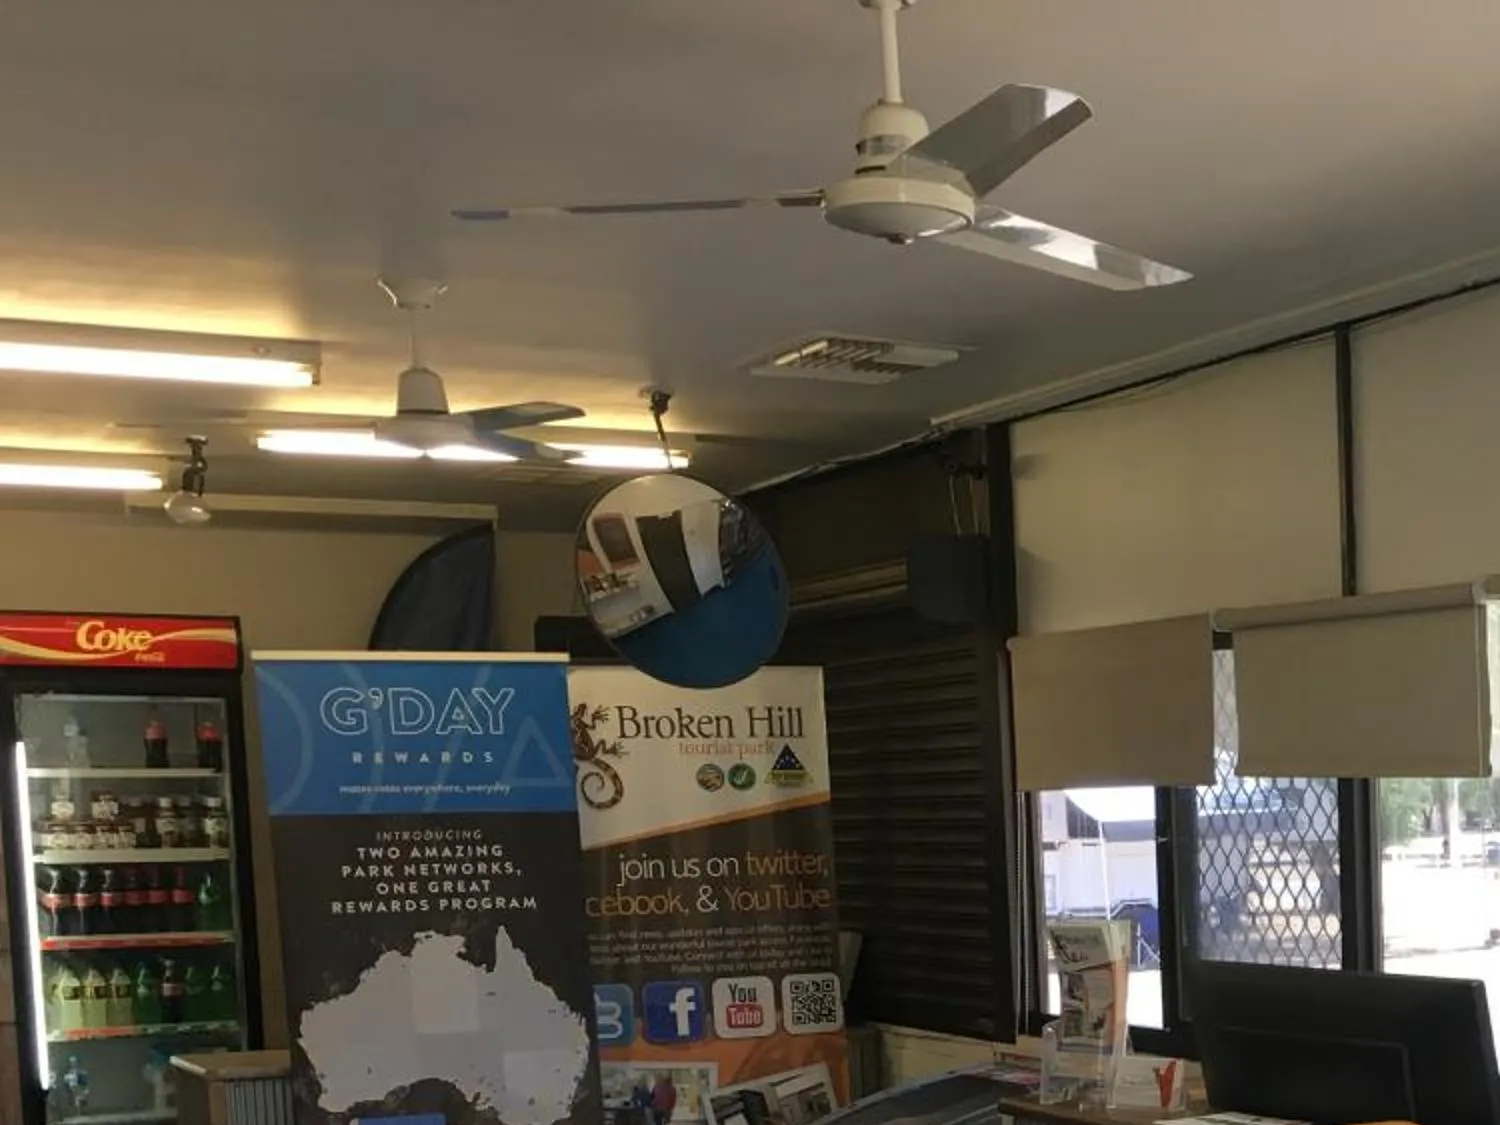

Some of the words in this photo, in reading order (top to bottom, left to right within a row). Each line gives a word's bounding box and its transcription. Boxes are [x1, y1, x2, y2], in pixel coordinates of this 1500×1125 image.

[75, 620, 154, 651] Coke
[319, 686, 516, 736] G'DAY
[614, 705, 736, 739] Broken
[745, 705, 806, 739] Hill
[352, 751, 494, 764] REWARDS
[376, 830, 482, 841] INTRODUCING
[357, 847, 401, 860] TWO
[411, 845, 503, 859] AMAZING
[341, 865, 395, 878] PARK
[404, 861, 522, 877] NETWORKS,
[616, 853, 665, 887] join
[671, 857, 700, 878] us
[706, 856, 739, 877] on
[745, 849, 829, 878] twitter,
[376, 882, 418, 895] ONE
[428, 879, 492, 894] GREAT
[331, 899, 430, 914] REWARDS
[439, 896, 537, 912] PROGRAM
[585, 887, 690, 918] cebook,
[696, 884, 720, 913] &
[723, 884, 832, 911] YouTube
[728, 983, 758, 1006] You
[729, 1005, 762, 1026] Tube
